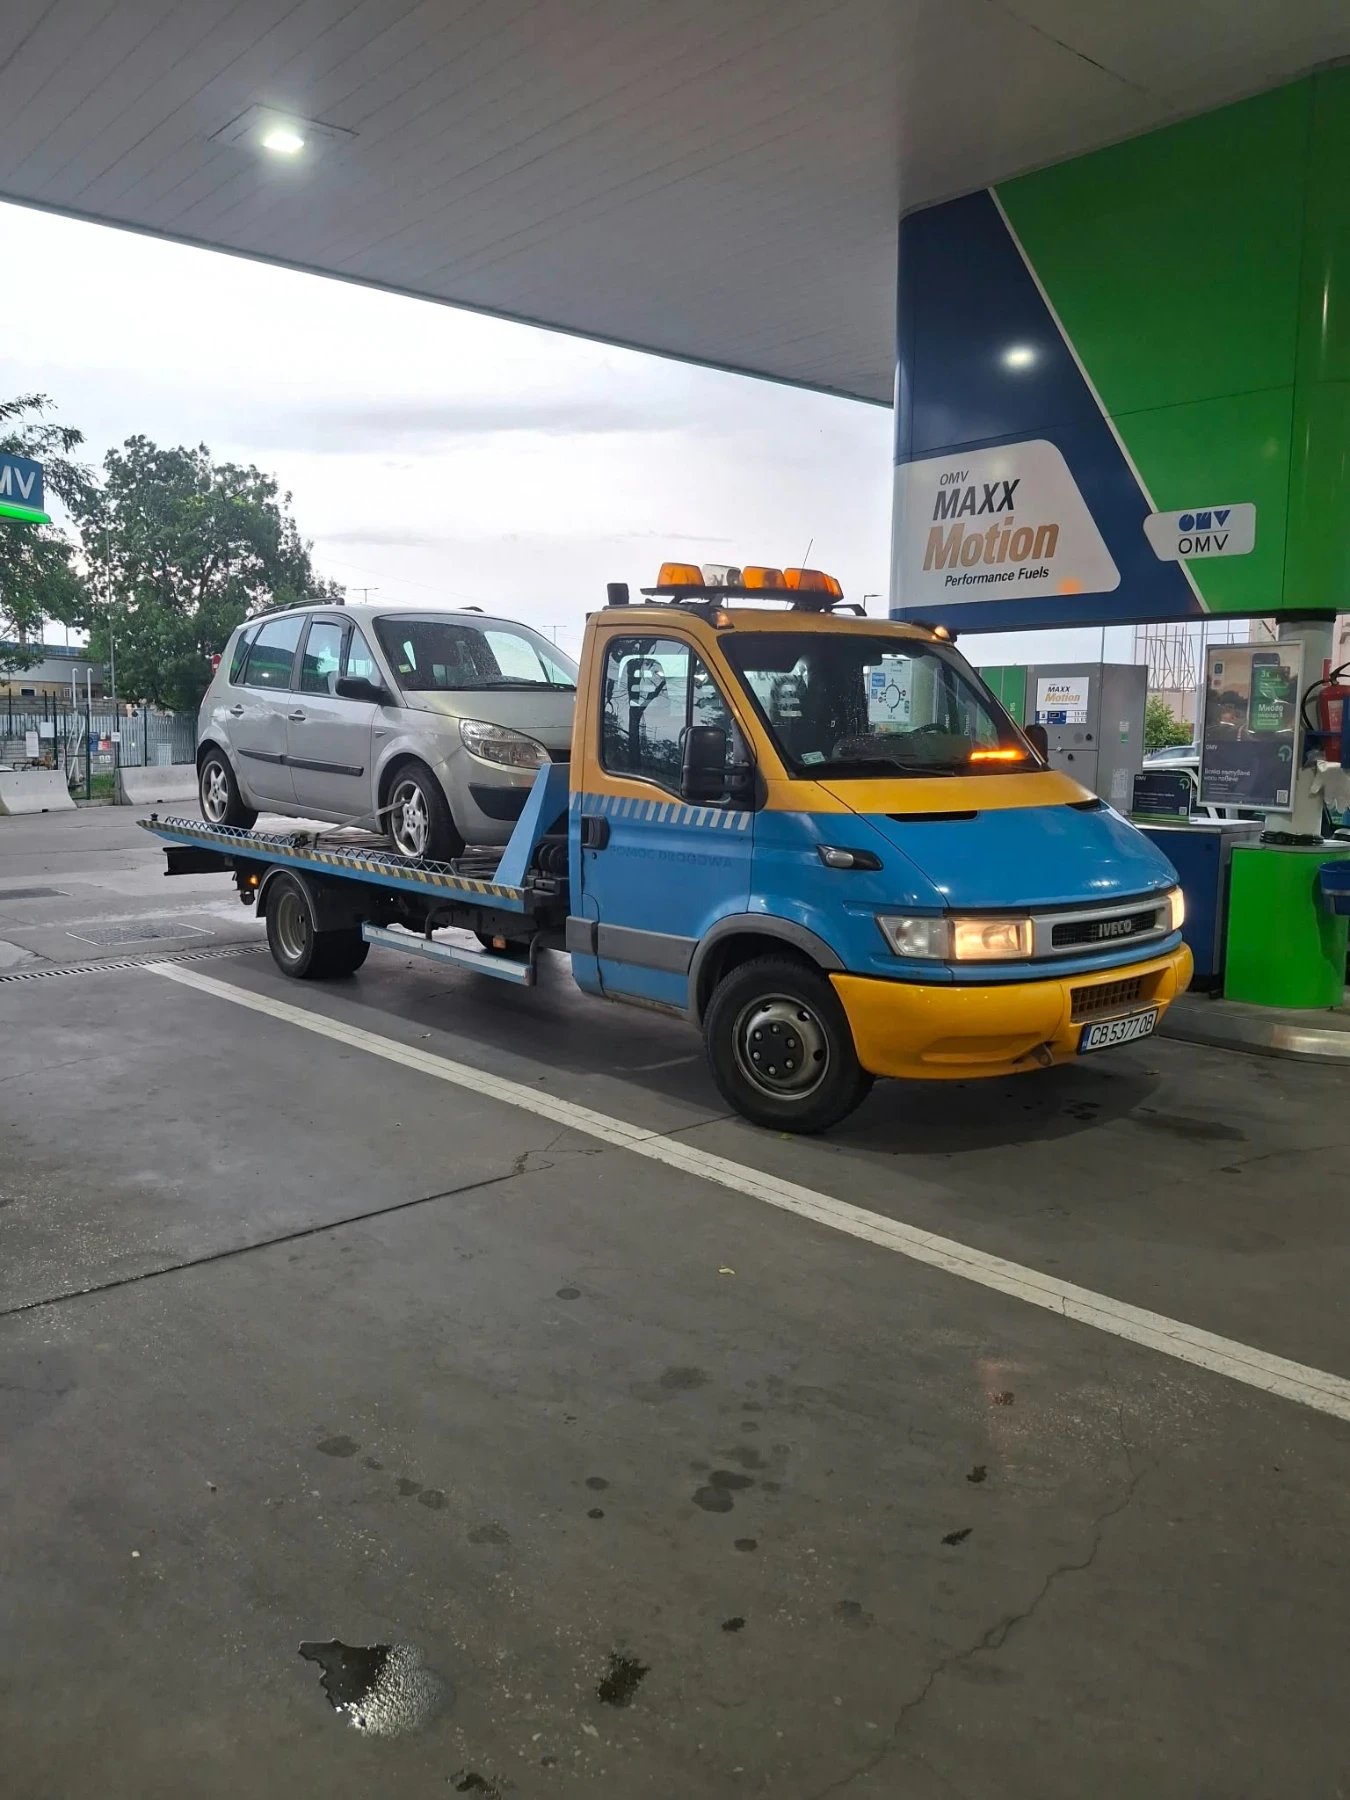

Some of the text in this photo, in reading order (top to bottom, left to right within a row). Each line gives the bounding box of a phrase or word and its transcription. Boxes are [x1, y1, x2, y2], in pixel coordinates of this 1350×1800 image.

[940, 470, 969, 485] OMV
[932, 479, 1021, 521] MAXX
[922, 516, 1060, 571] Motion
[1178, 534, 1229, 554] OMV
[944, 566, 1050, 587] Performance Fuels
[1045, 693, 1080, 702] Motion
[1099, 919, 1132, 938] IVECO
[1090, 1025, 1109, 1046] CB
[1109, 1018, 1140, 1042] 5377
